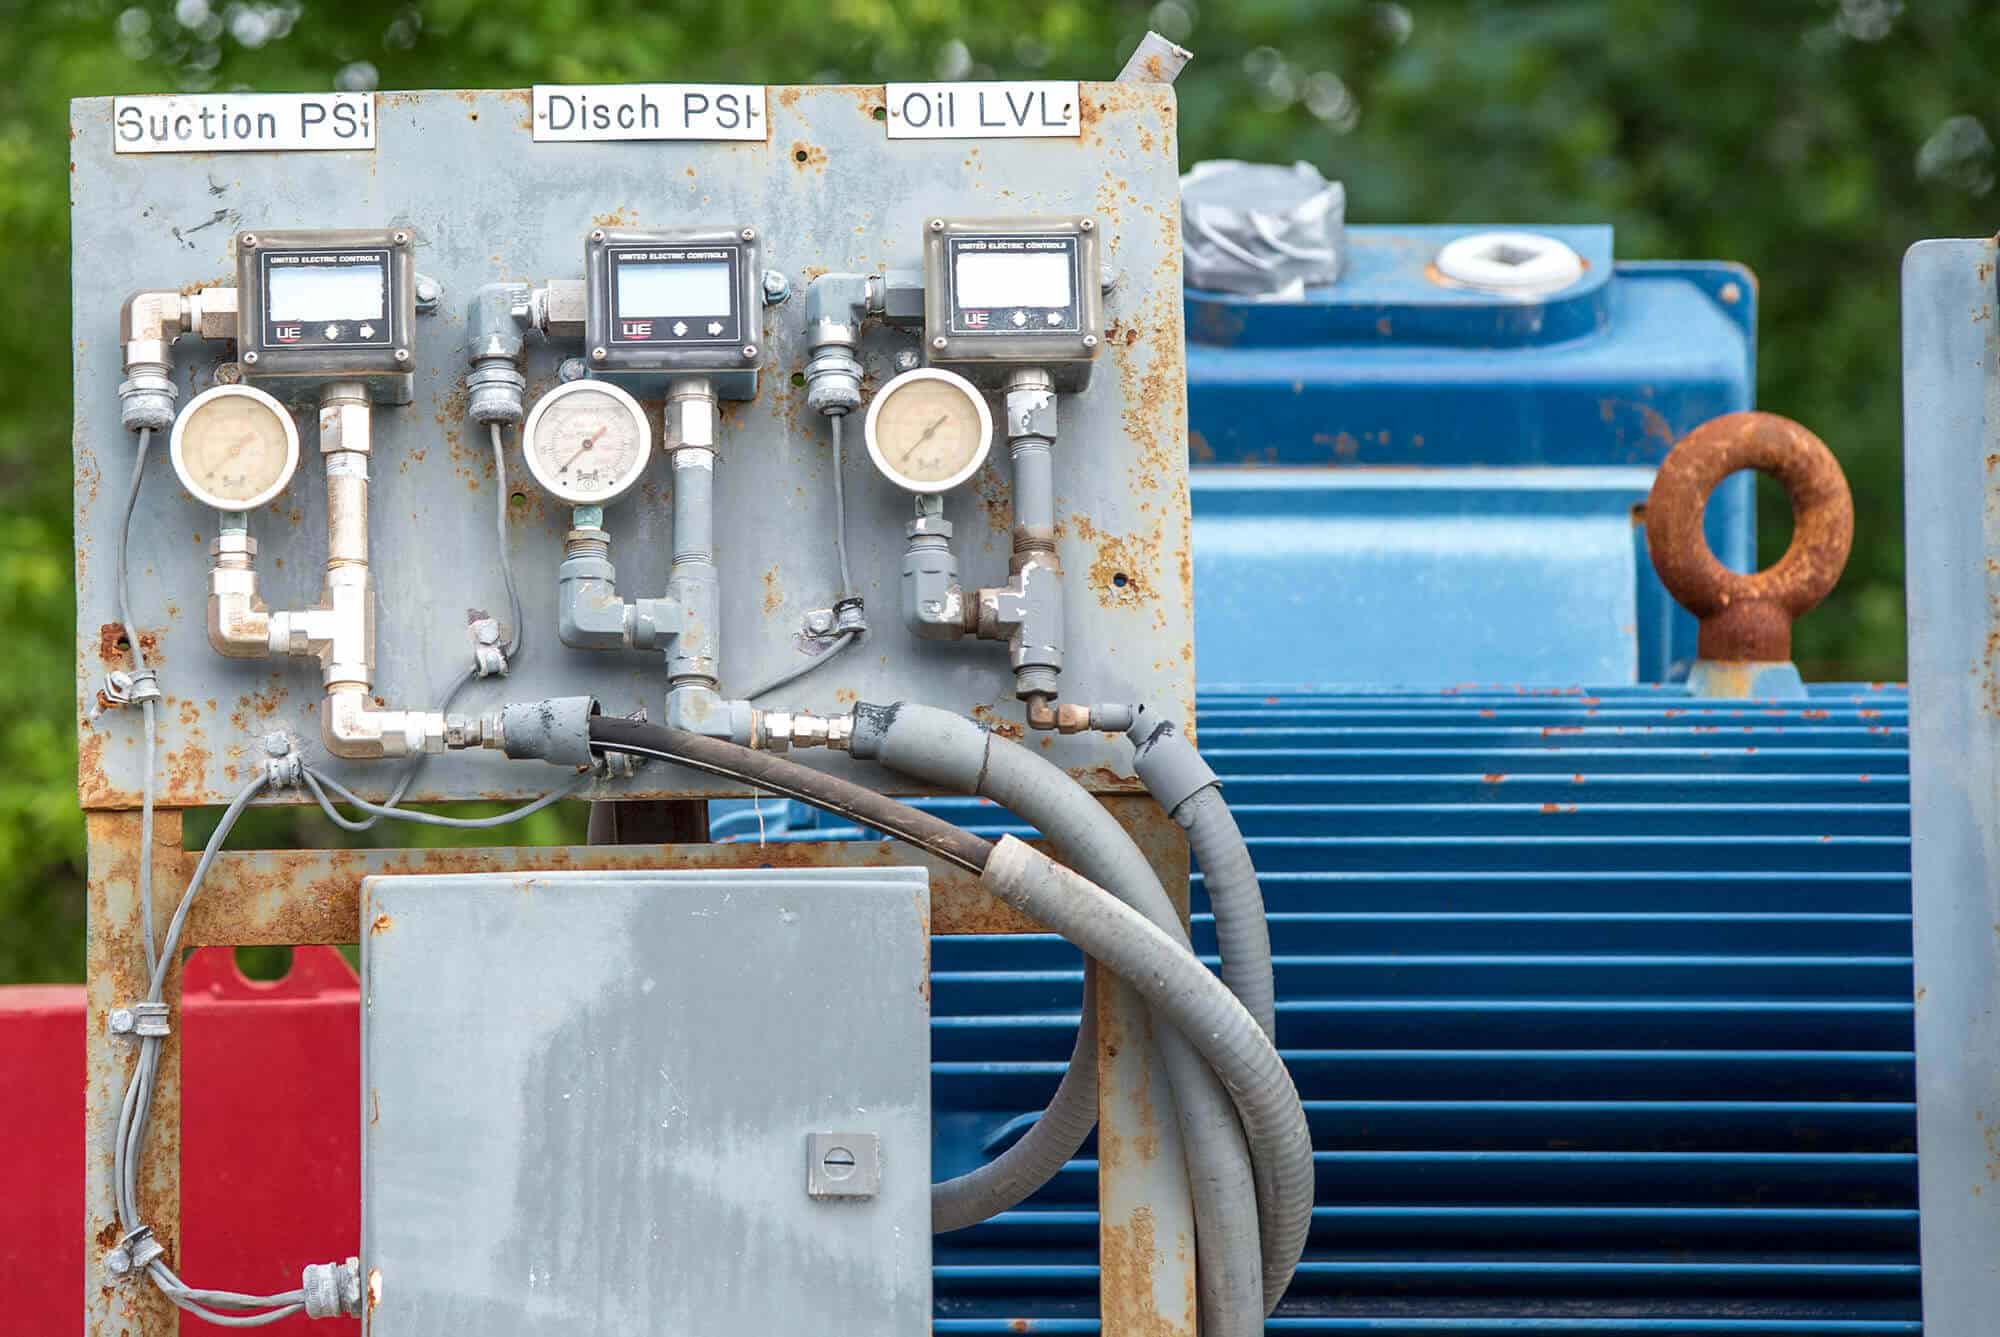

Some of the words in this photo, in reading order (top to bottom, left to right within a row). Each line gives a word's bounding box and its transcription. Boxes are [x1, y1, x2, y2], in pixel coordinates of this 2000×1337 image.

[117, 104, 277, 142] Suction
[300, 101, 370, 138] PSI
[548, 93, 660, 130] Disch
[684, 93, 752, 129] PSI
[903, 91, 955, 128] Oil
[978, 91, 1068, 127] LVL
[649, 252, 686, 260] ELECTRIC
